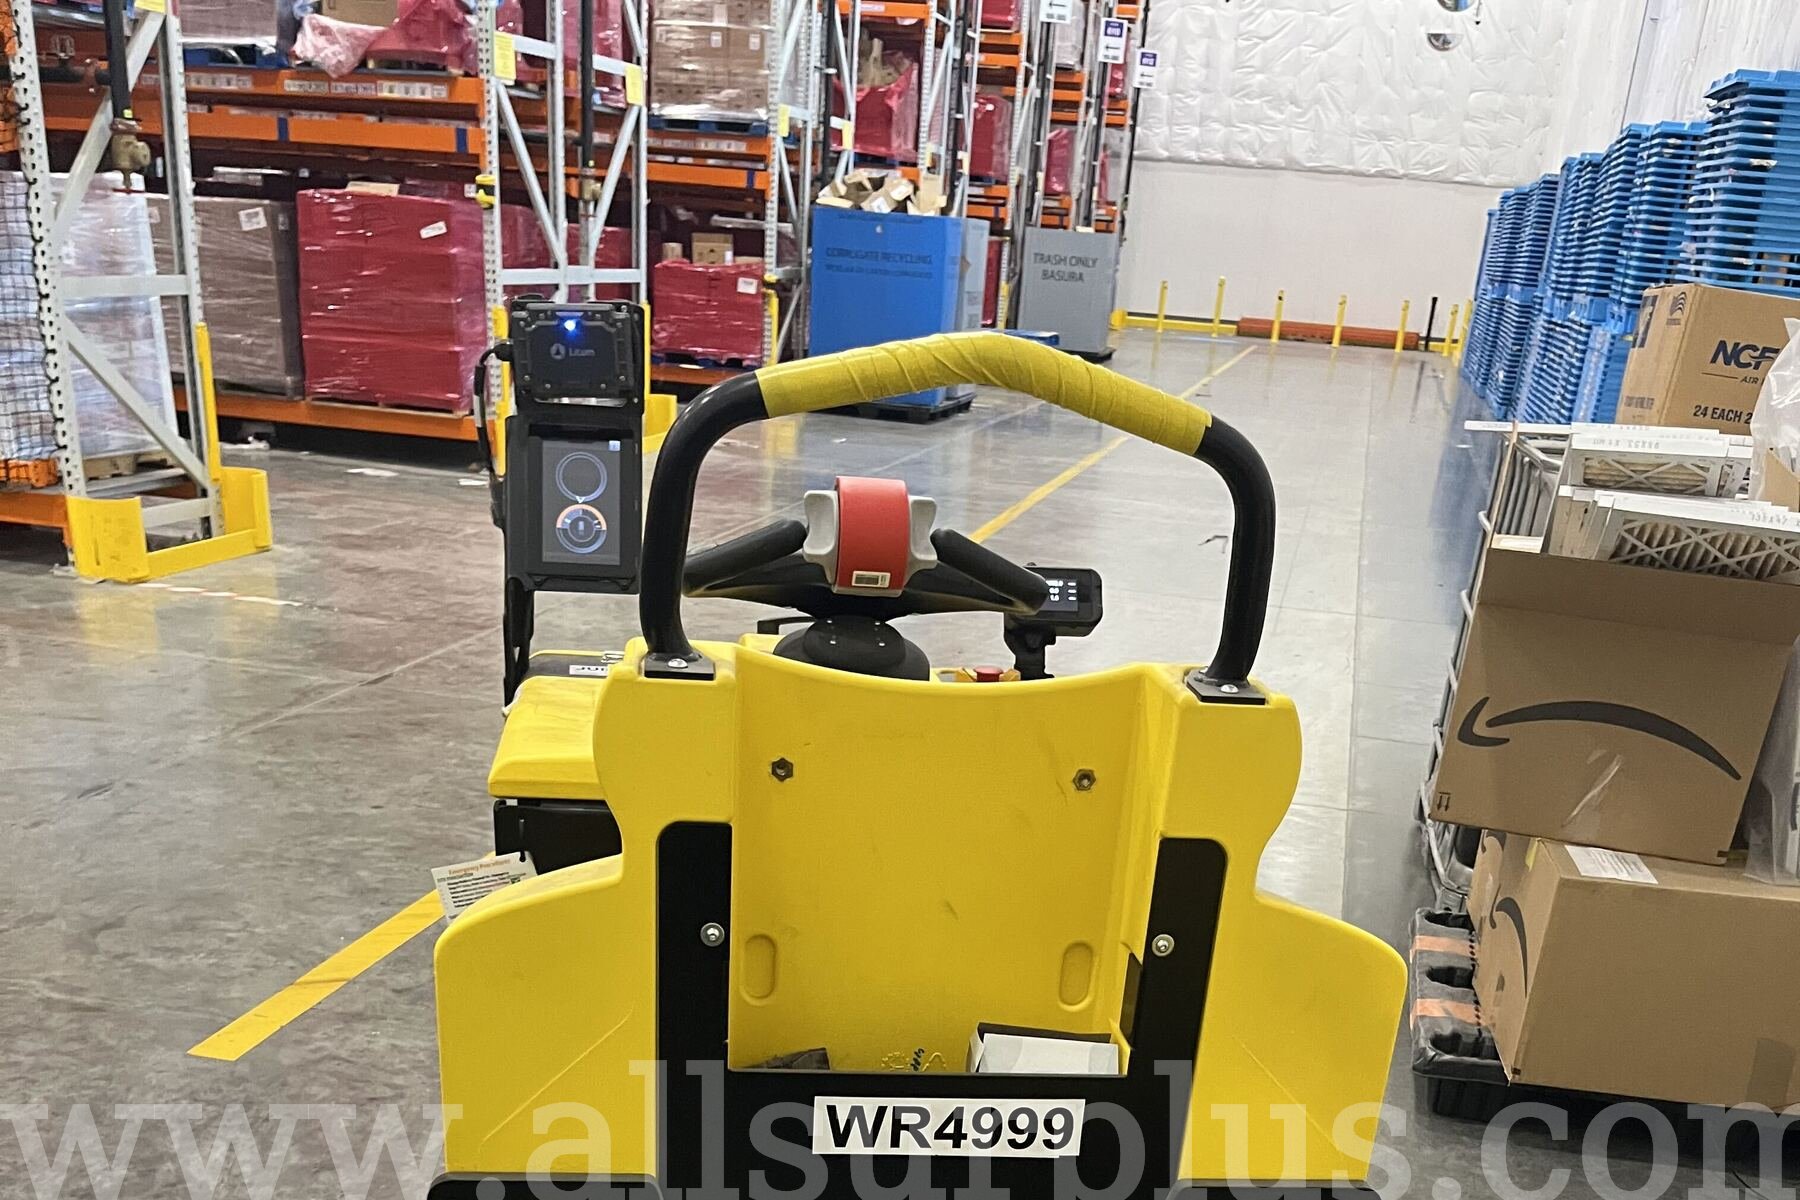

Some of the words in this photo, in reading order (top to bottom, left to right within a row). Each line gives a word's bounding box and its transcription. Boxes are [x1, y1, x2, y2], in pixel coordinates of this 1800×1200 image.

[1033, 253, 1067, 267] TRASH
[1069, 255, 1098, 268] ONLY
[1041, 269, 1085, 282] BASURA
[1693, 405, 1708, 418] 24
[1710, 409, 1742, 422] EACH
[826, 1104, 1074, 1150] WR4999
